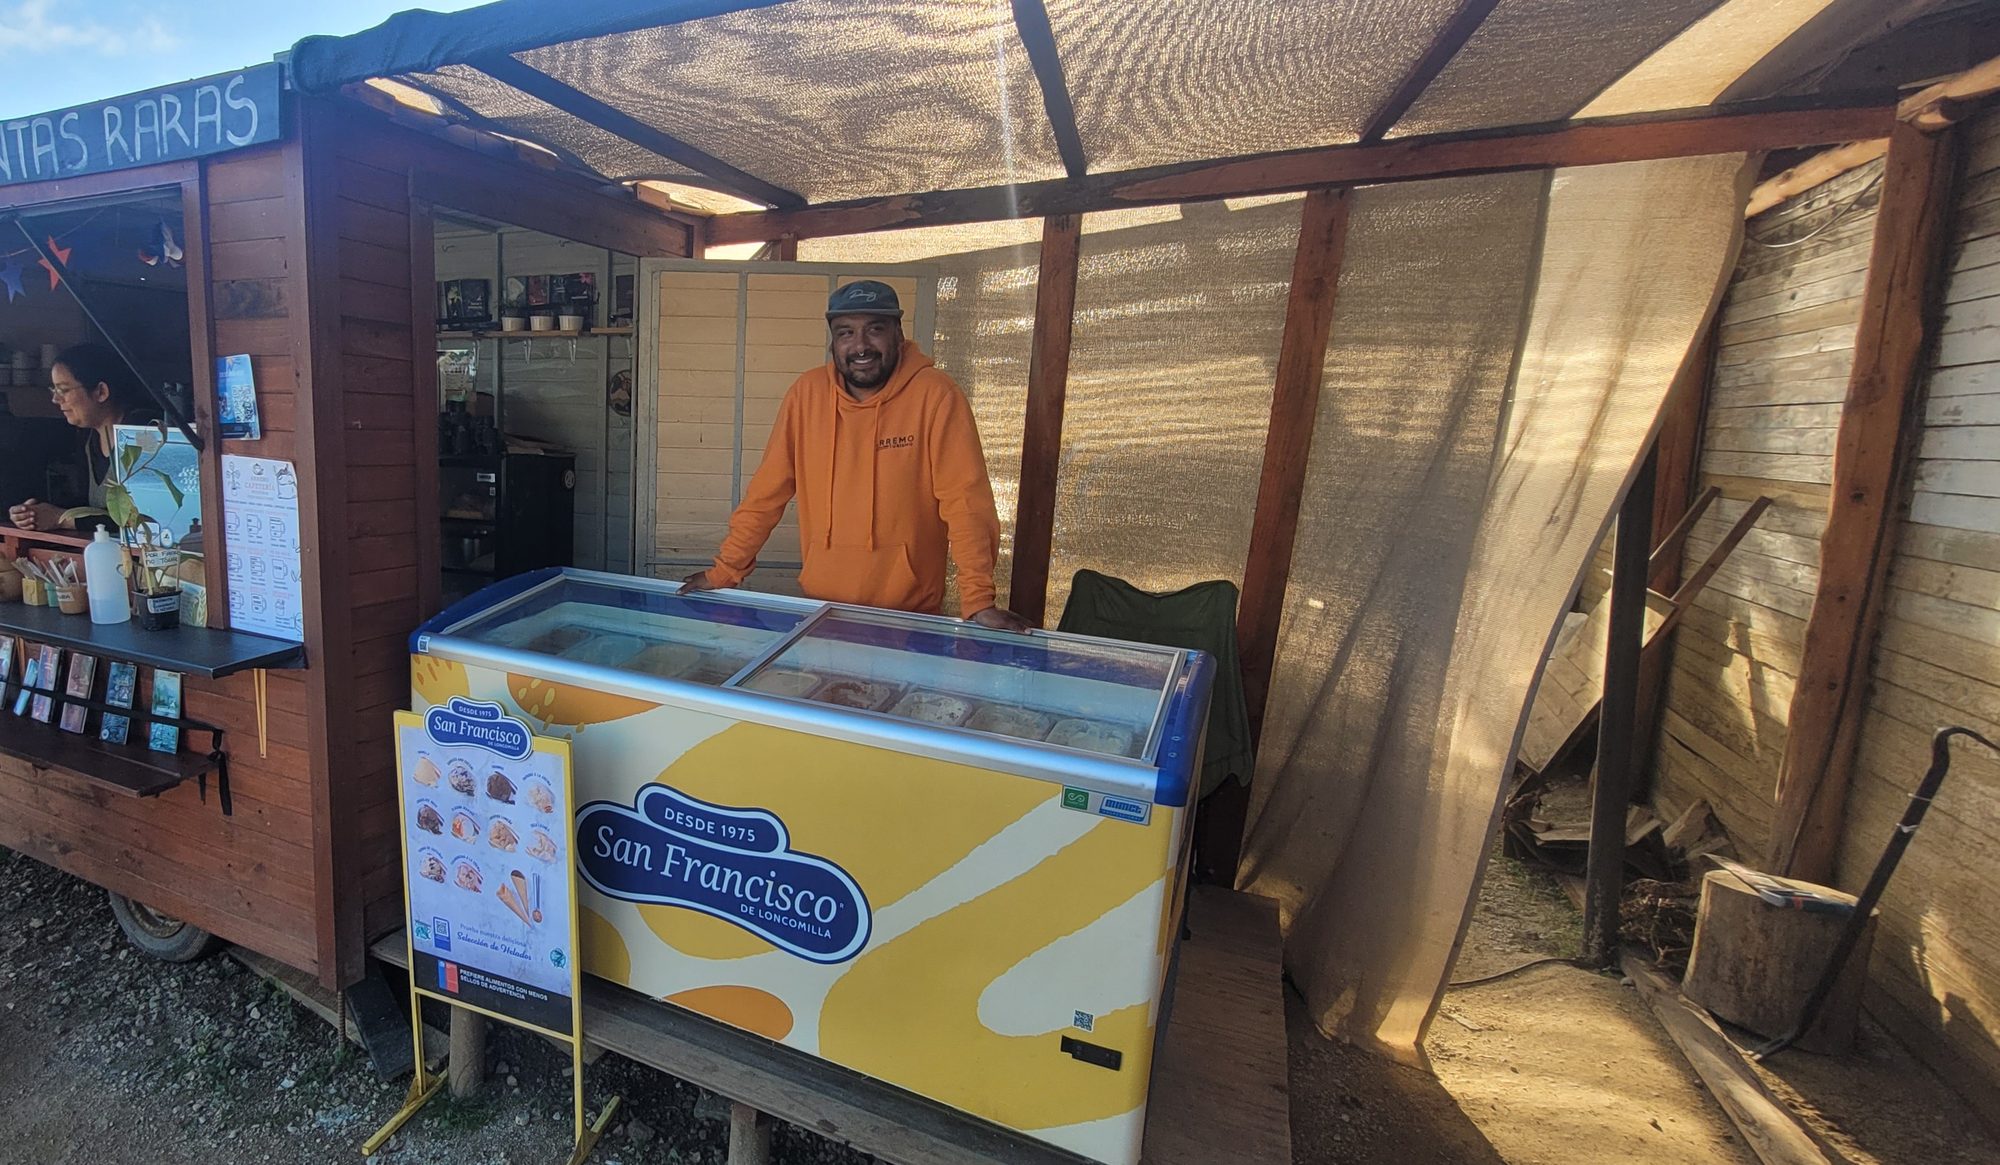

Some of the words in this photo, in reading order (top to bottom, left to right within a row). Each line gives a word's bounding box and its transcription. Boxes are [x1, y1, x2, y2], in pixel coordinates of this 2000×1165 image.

[103, 75, 258, 166] RARAS
[459, 706, 478, 716] DESDE
[433, 716, 457, 734] San
[459, 720, 521, 745] Francisco
[664, 807, 715, 835] DESDE
[721, 824, 756, 842] 1975
[594, 825, 652, 871] San
[660, 843, 837, 923] Francisco
[740, 903, 755, 916] DE
[758, 909, 832, 939] LONCOMILLA
[457, 931, 488, 948] Selección
[490, 941, 500, 951] de
[501, 943, 532, 960] Helados
[460, 968, 485, 981] PREFIERE
[485, 976, 515, 990] ALIMENTOS
[516, 986, 528, 995] CON
[528, 990, 548, 1001] MENOS
[460, 974, 480, 986] SELLOS
[481, 981, 488, 989] DE
[489, 983, 526, 1000] ADVERTENCIA
